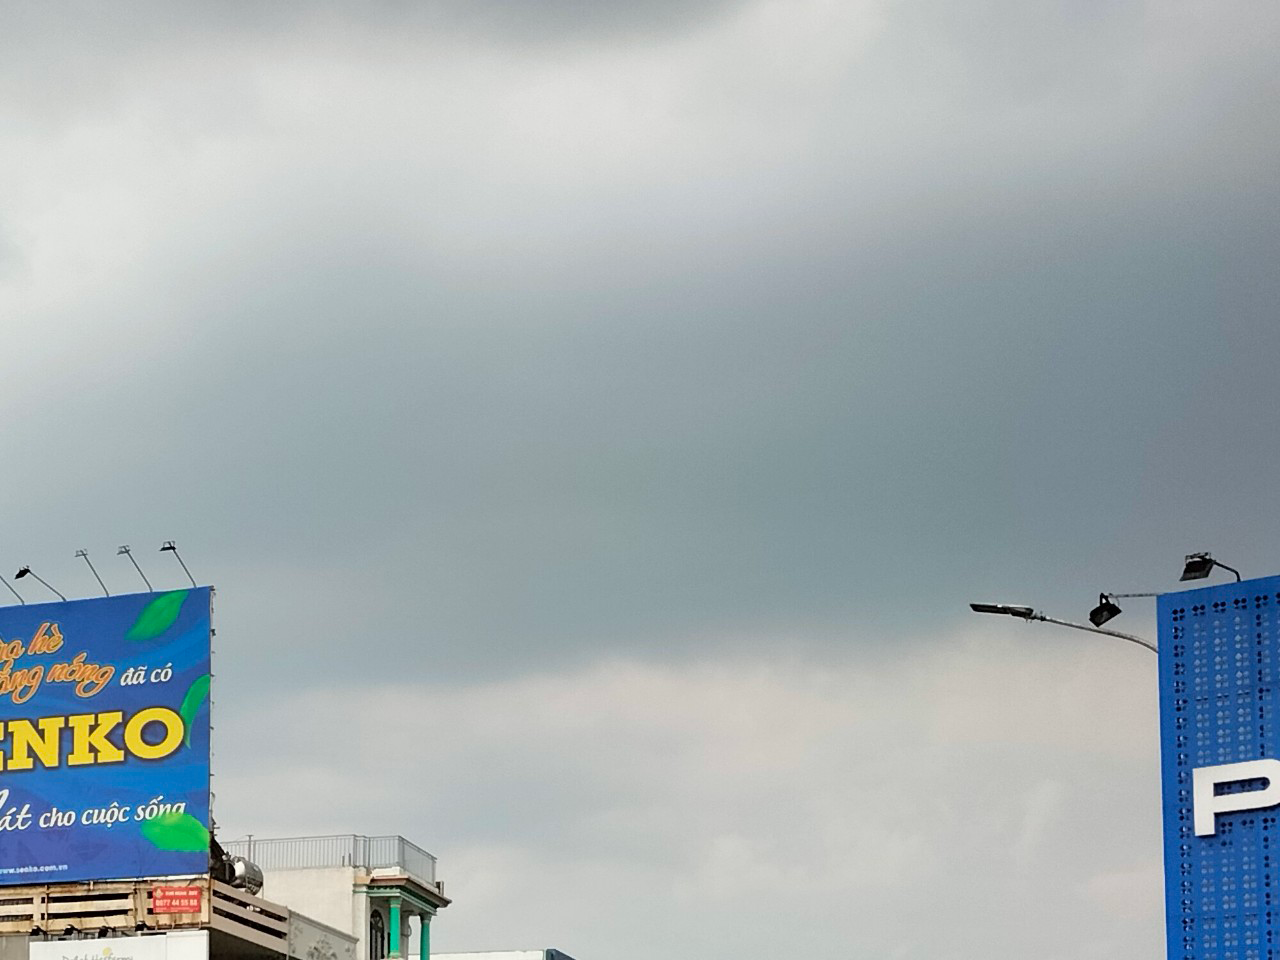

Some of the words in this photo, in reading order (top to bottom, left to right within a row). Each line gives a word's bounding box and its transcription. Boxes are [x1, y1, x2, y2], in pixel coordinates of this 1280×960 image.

[28, 622, 64, 656] hè
[46, 652, 116, 698] nóng
[120, 666, 148, 687] đã
[150, 662, 173, 682] có
[39, 806, 76, 827] cho
[81, 802, 130, 825] cuộc
